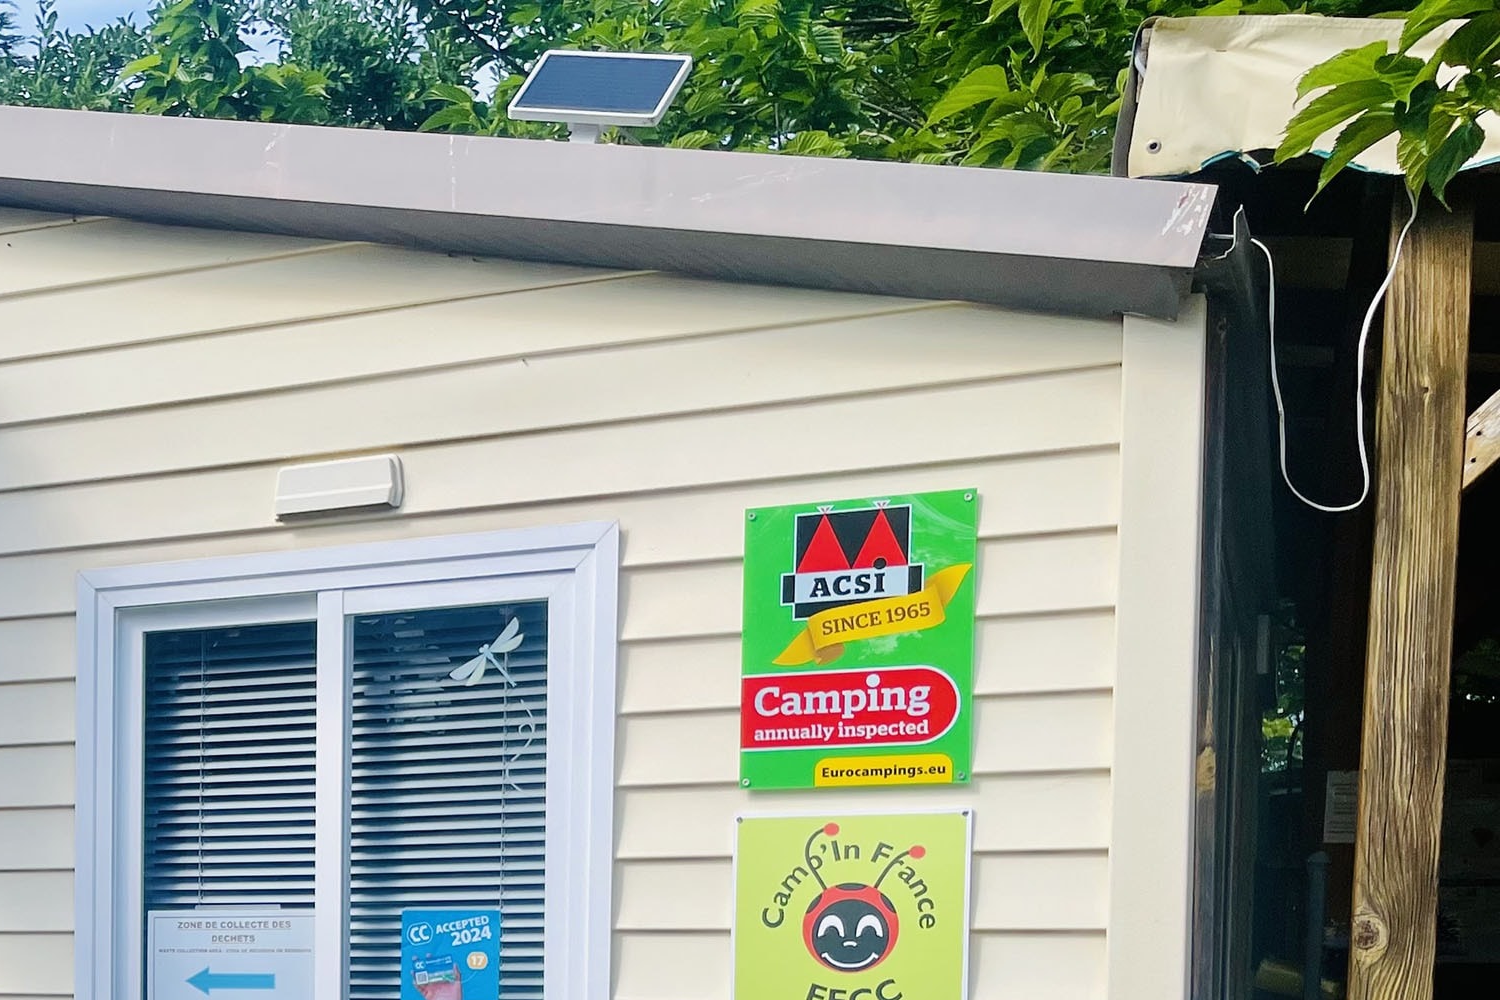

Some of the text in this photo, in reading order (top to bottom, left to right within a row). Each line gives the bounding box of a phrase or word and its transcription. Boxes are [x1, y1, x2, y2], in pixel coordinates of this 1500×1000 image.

[822, 602, 931, 636] SINCE 1965
[754, 673, 932, 719] Camping
[754, 719, 929, 742] annually inspected
[822, 764, 947, 779] Eurocampings.eu
[177, 921, 292, 929] ZONE DE COLLECTE DES
[409, 915, 490, 942] CC ACCEPTED
[211, 934, 256, 943] DECHETS
[450, 926, 493, 947] 2024
